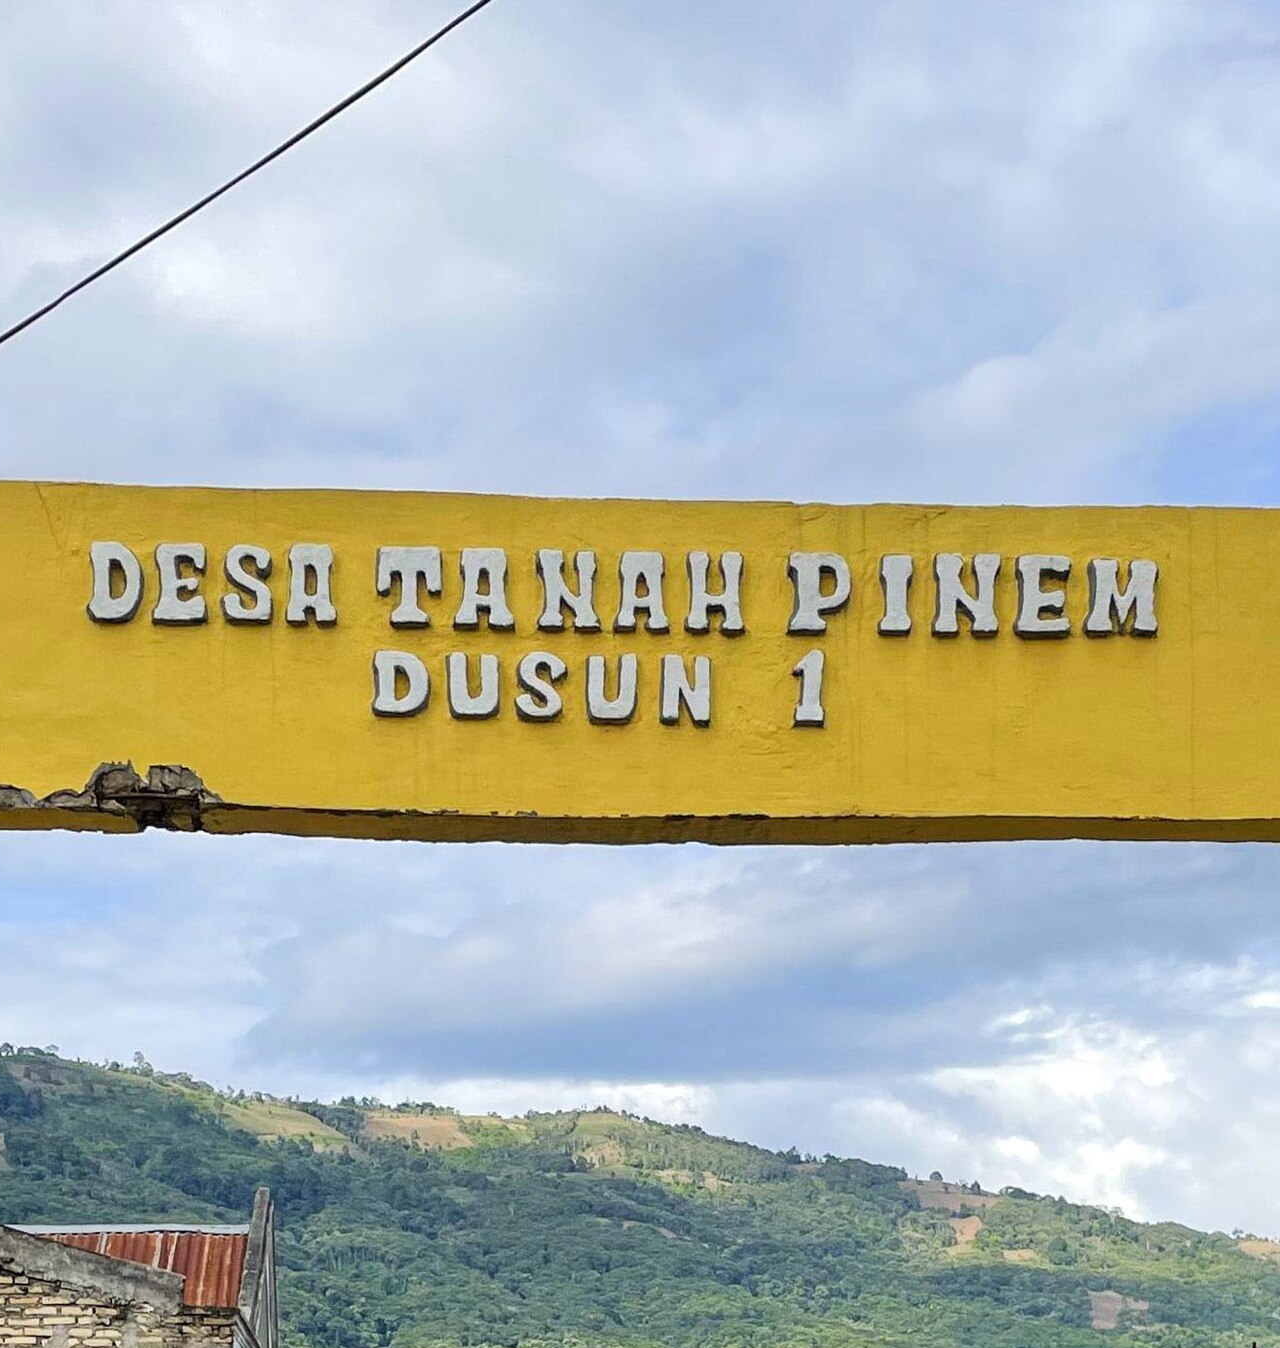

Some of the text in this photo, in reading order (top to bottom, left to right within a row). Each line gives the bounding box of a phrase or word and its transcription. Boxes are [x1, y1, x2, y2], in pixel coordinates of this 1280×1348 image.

[87, 541, 1159, 638] DESA TANAH PINEM
[371, 648, 826, 728] DUSUN 1
